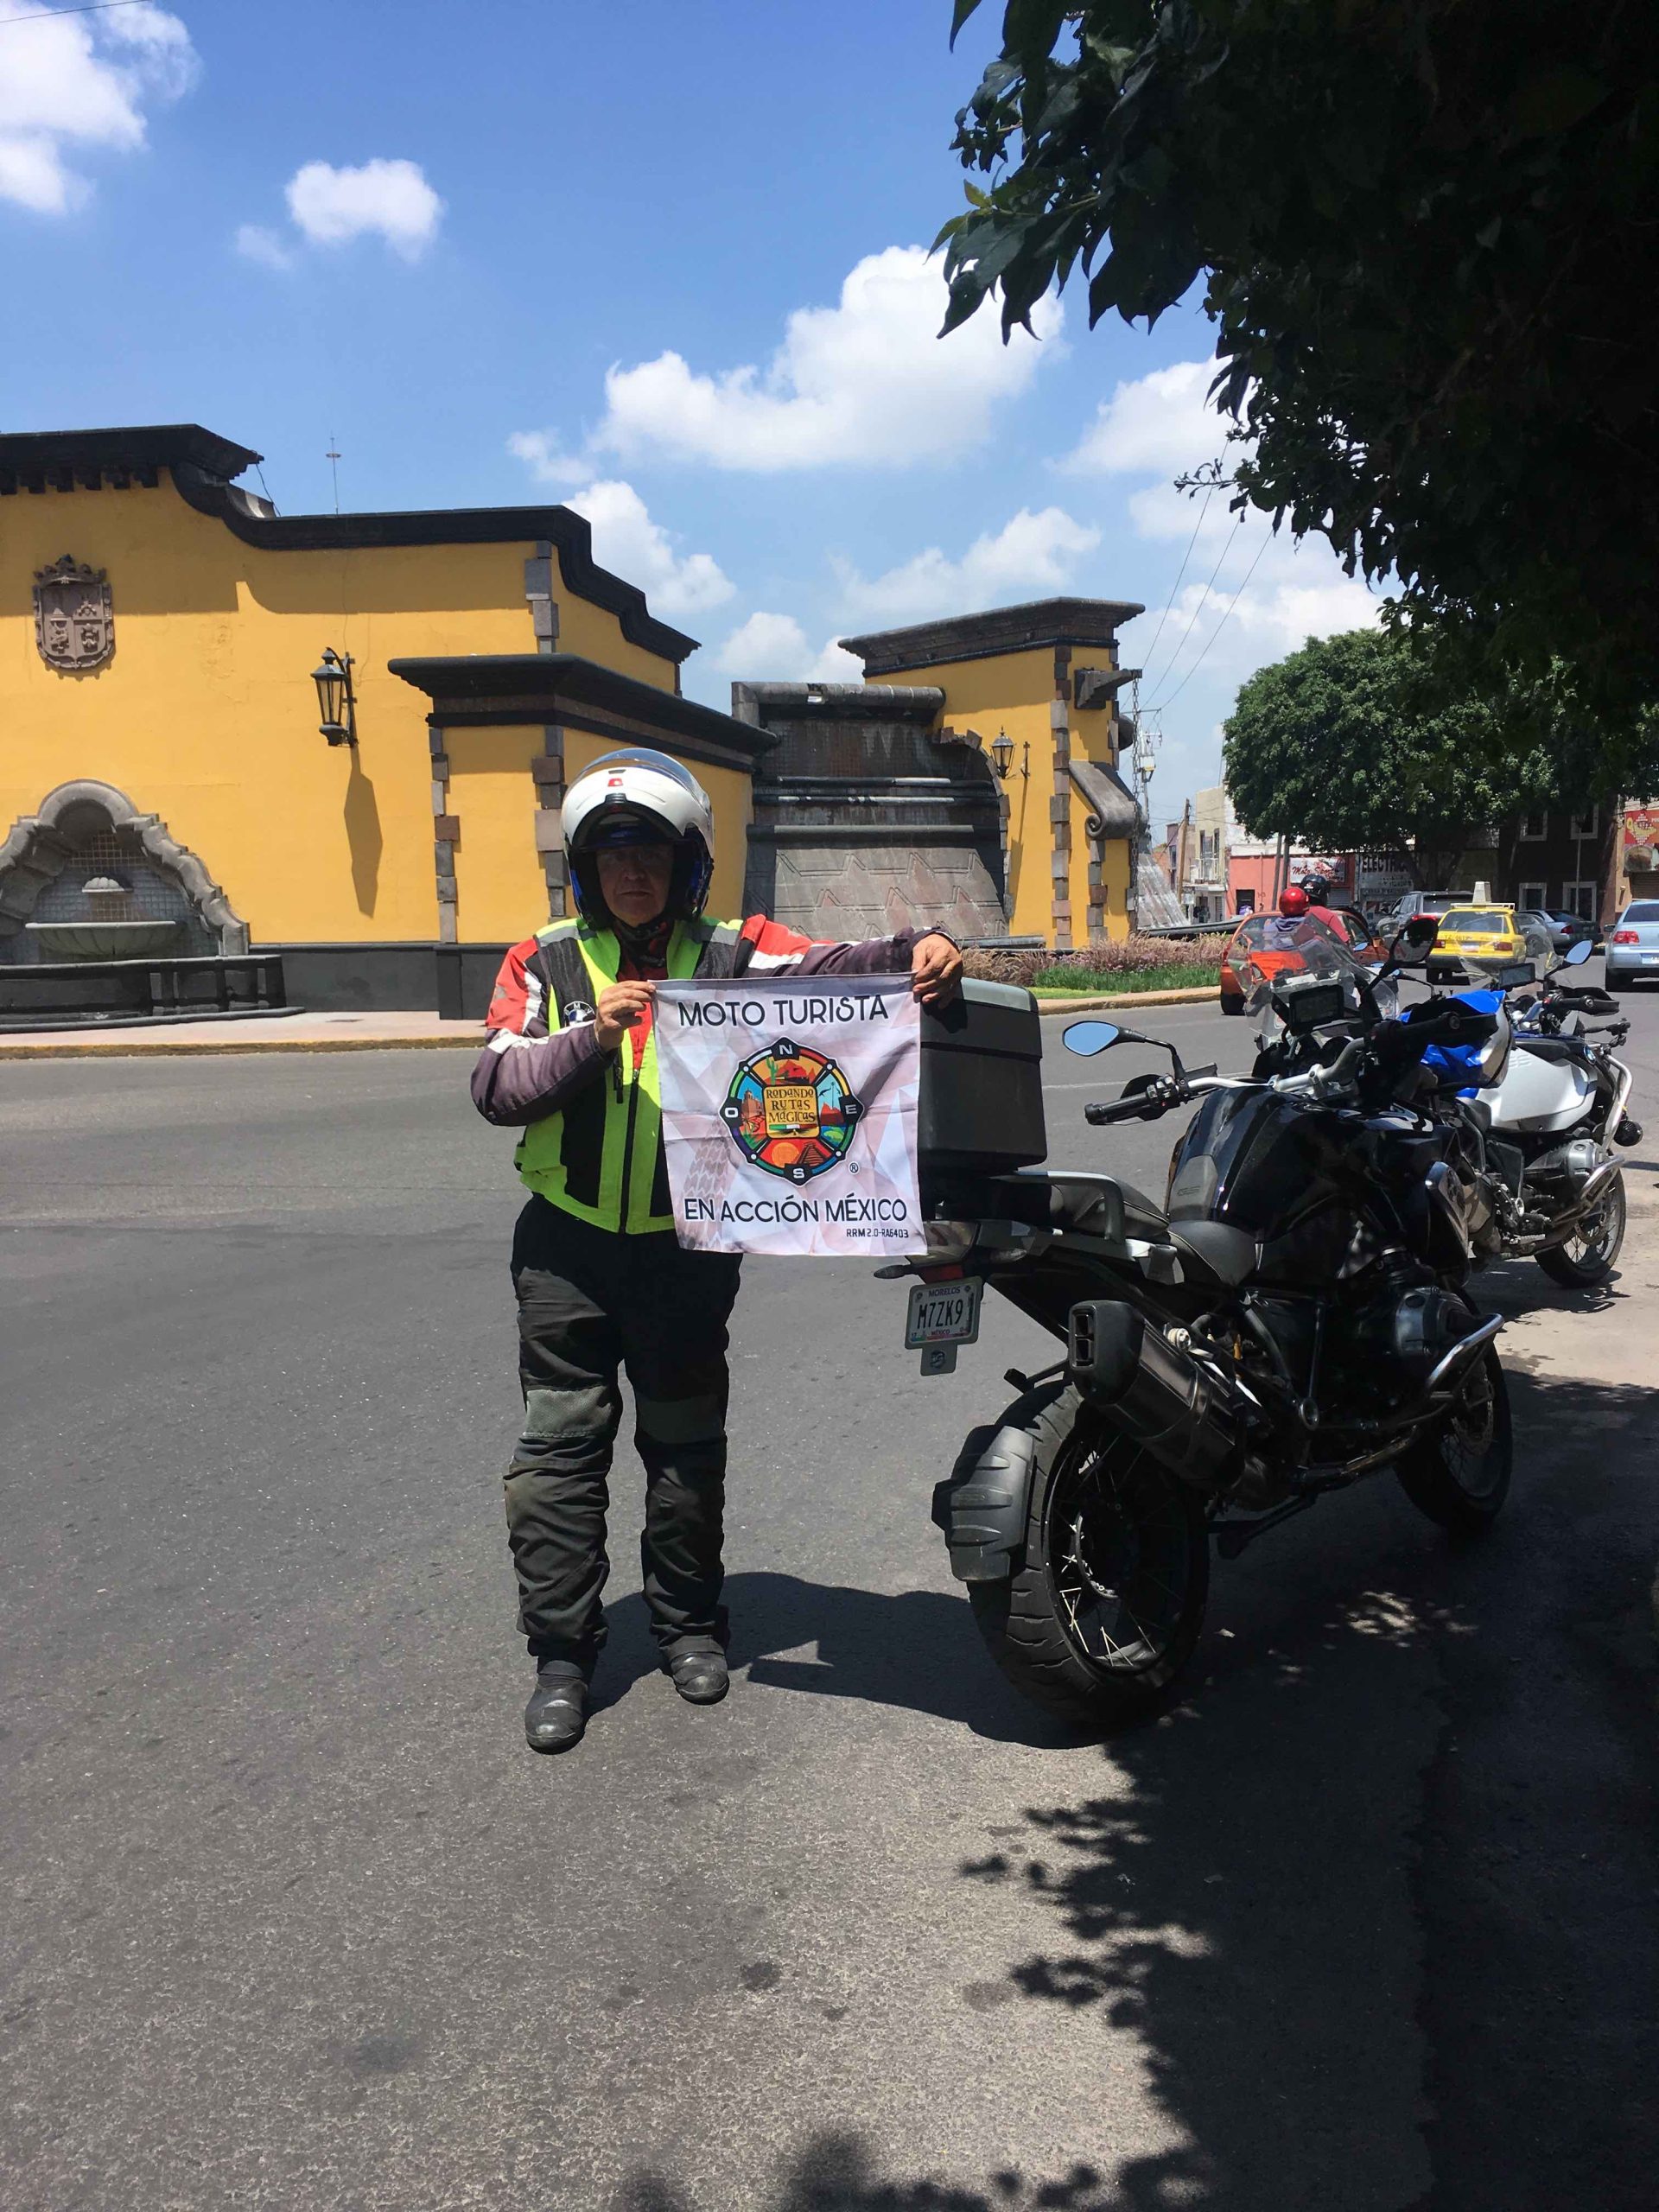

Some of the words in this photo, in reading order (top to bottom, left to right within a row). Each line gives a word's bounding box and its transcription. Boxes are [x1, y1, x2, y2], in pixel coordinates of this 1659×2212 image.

[677, 1001, 766, 1027] MOTO
[773, 994, 888, 1026] TURISTA
[779, 1044, 793, 1055] N
[724, 1107, 739, 1118] O
[845, 1103, 857, 1115] E
[793, 1167, 804, 1179] S
[683, 1198, 715, 1221] EN
[721, 1194, 820, 1224] ACCIÓN
[826, 1192, 907, 1223] MÉXICO
[846, 1228, 866, 1237] RRM
[929, 1286, 961, 1297] MORELOS
